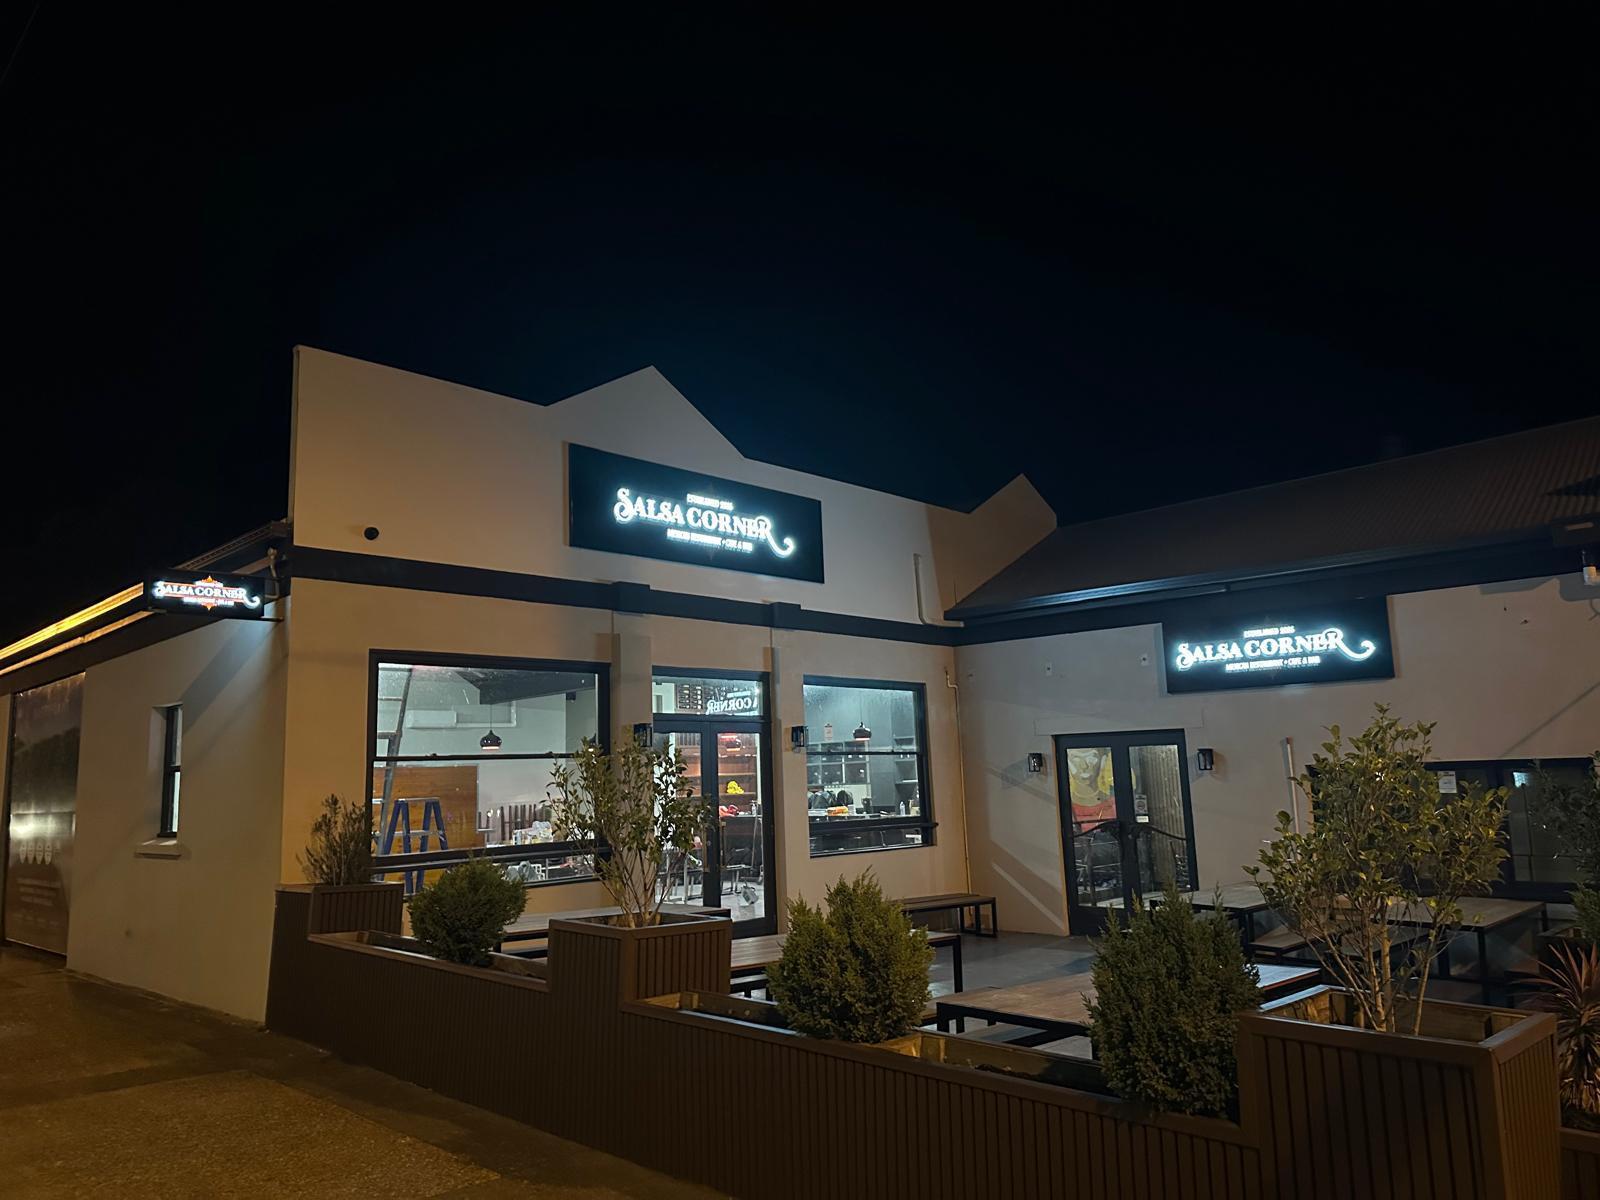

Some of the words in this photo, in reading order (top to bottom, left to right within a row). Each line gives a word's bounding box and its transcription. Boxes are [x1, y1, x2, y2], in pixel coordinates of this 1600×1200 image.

[613, 486, 686, 525] SALSA
[686, 506, 796, 558] CORNER
[153, 581, 194, 598] SALSA
[195, 587, 261, 609] CORNER
[1175, 641, 1244, 671] SALSA
[1244, 627, 1377, 661] CORNER
